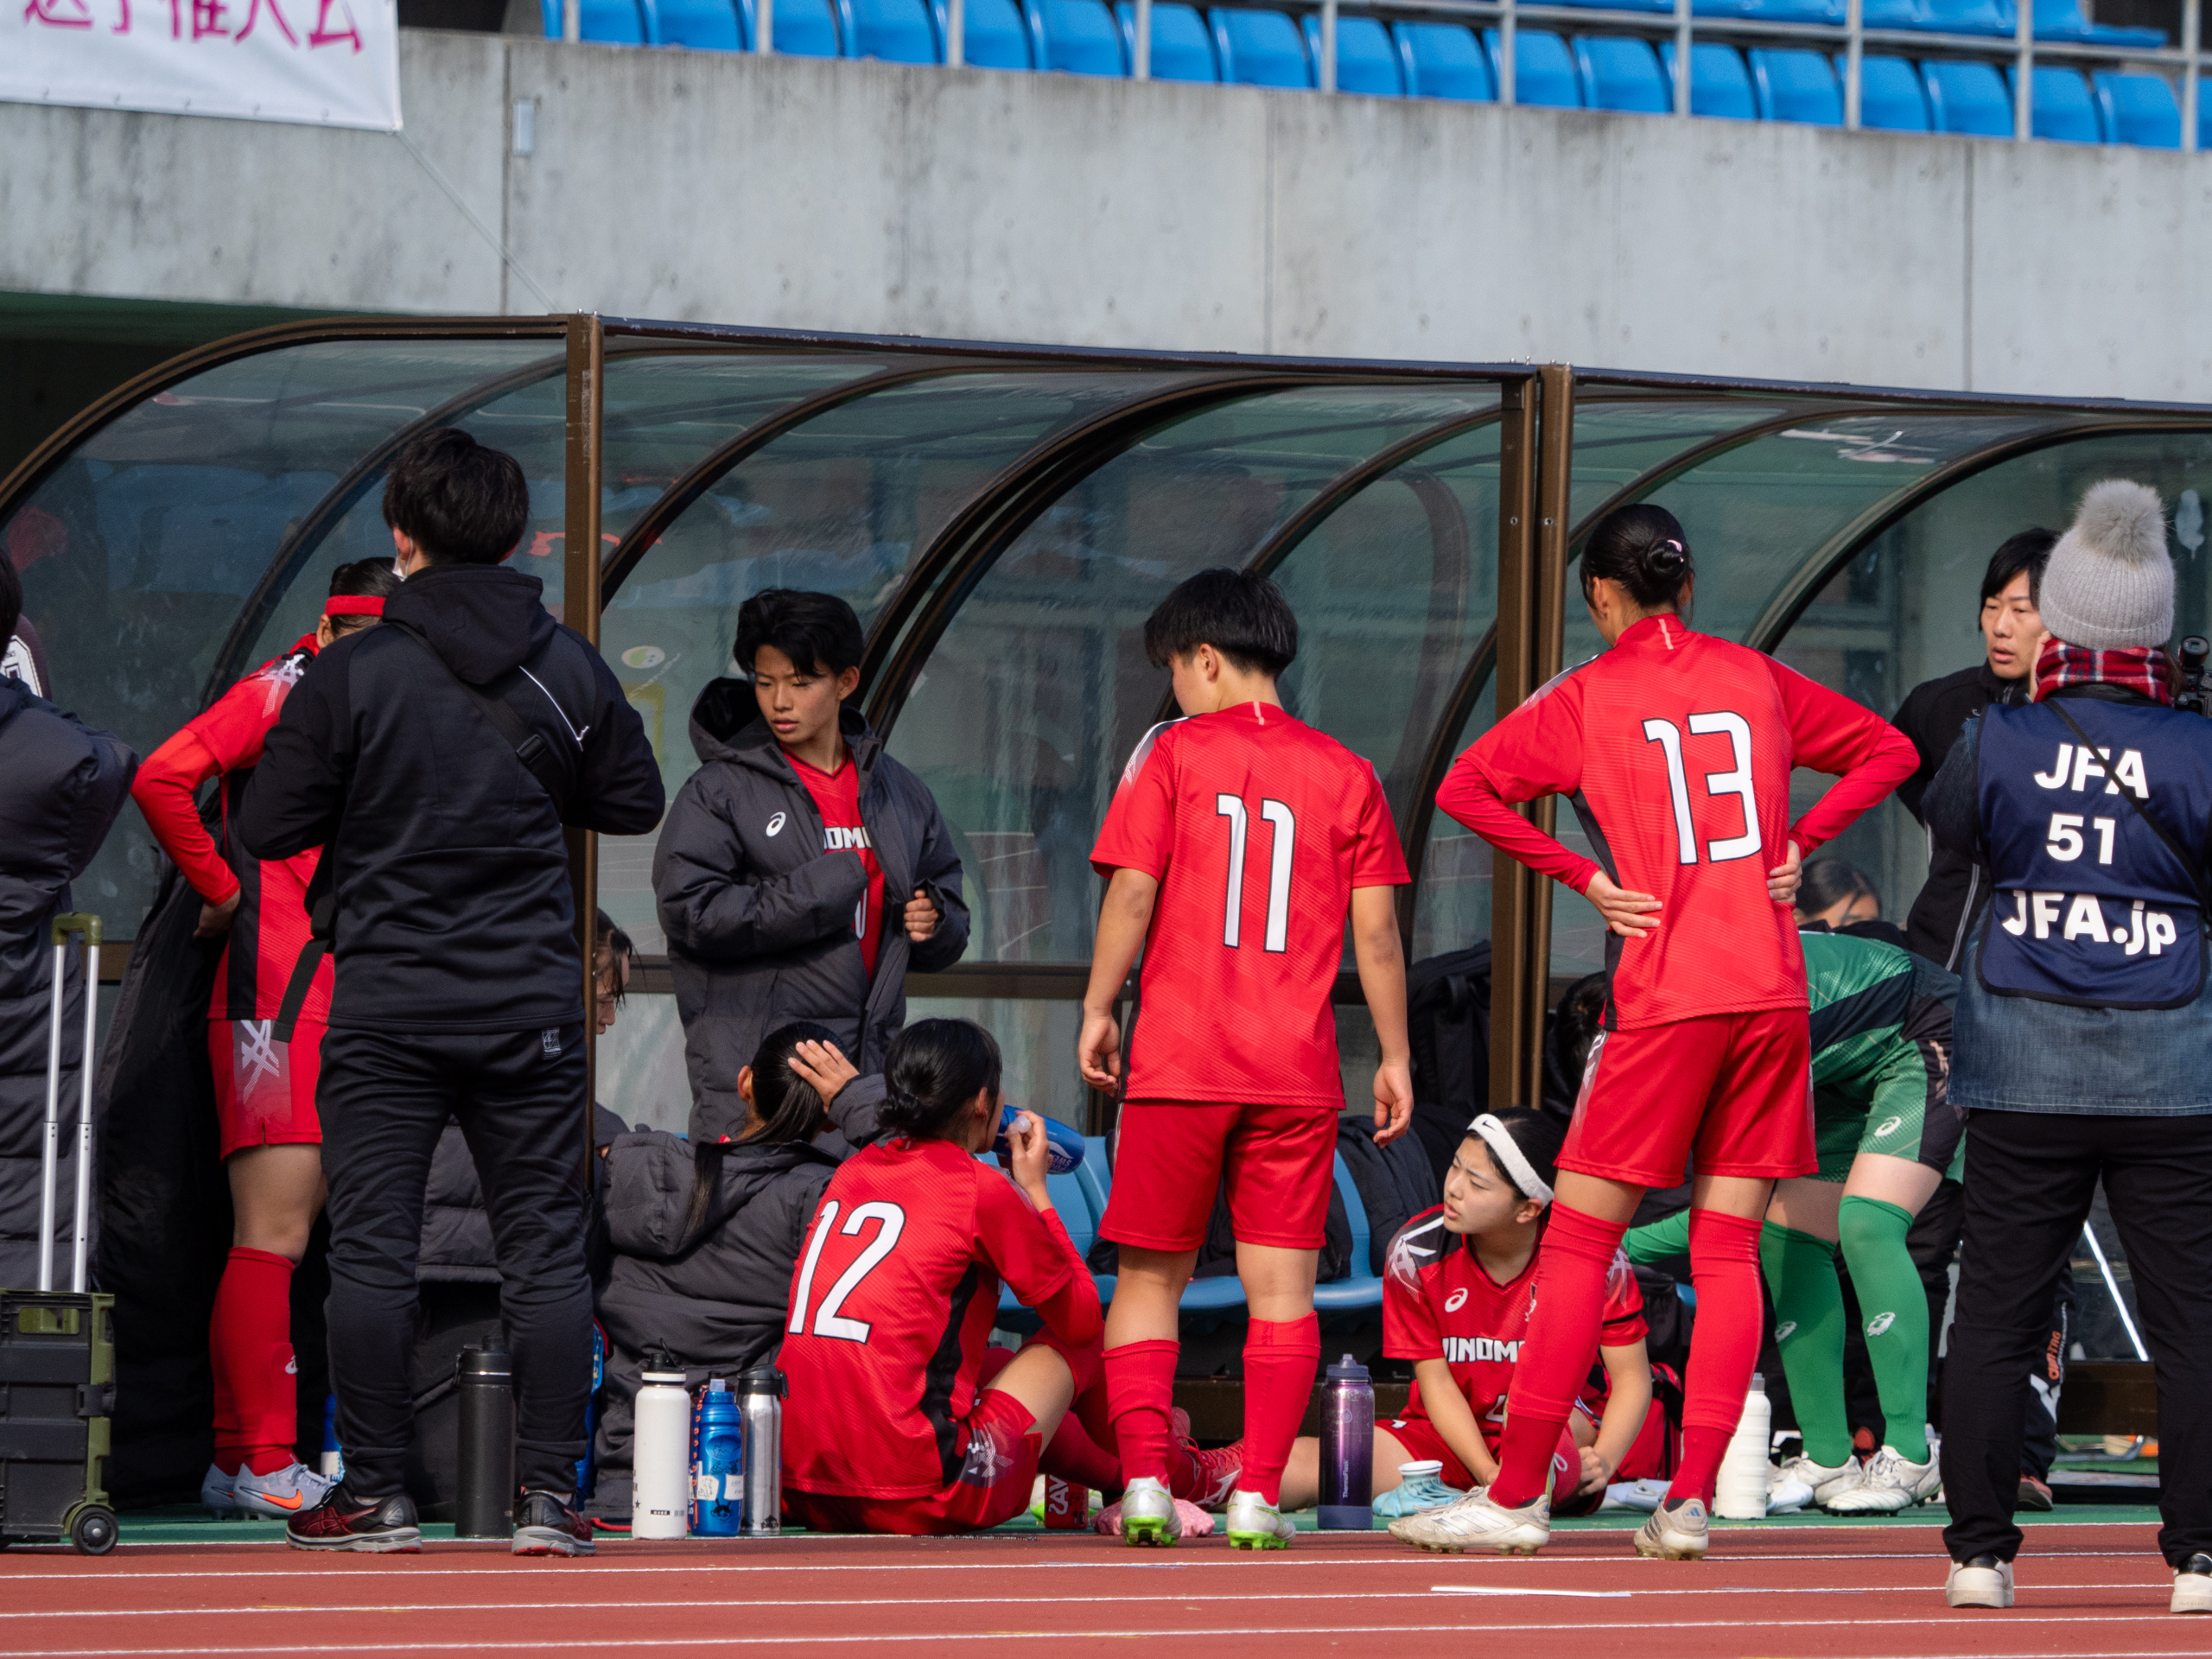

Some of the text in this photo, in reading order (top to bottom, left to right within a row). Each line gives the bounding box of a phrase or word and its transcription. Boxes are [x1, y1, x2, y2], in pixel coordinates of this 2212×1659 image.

[1643, 710, 1762, 865] 13
[2034, 743, 2150, 799] JFA
[1217, 792, 1296, 953] 11
[2046, 812, 2116, 865] 51
[2002, 889, 2177, 955] JFA.jp
[787, 1199, 906, 1344] 12
